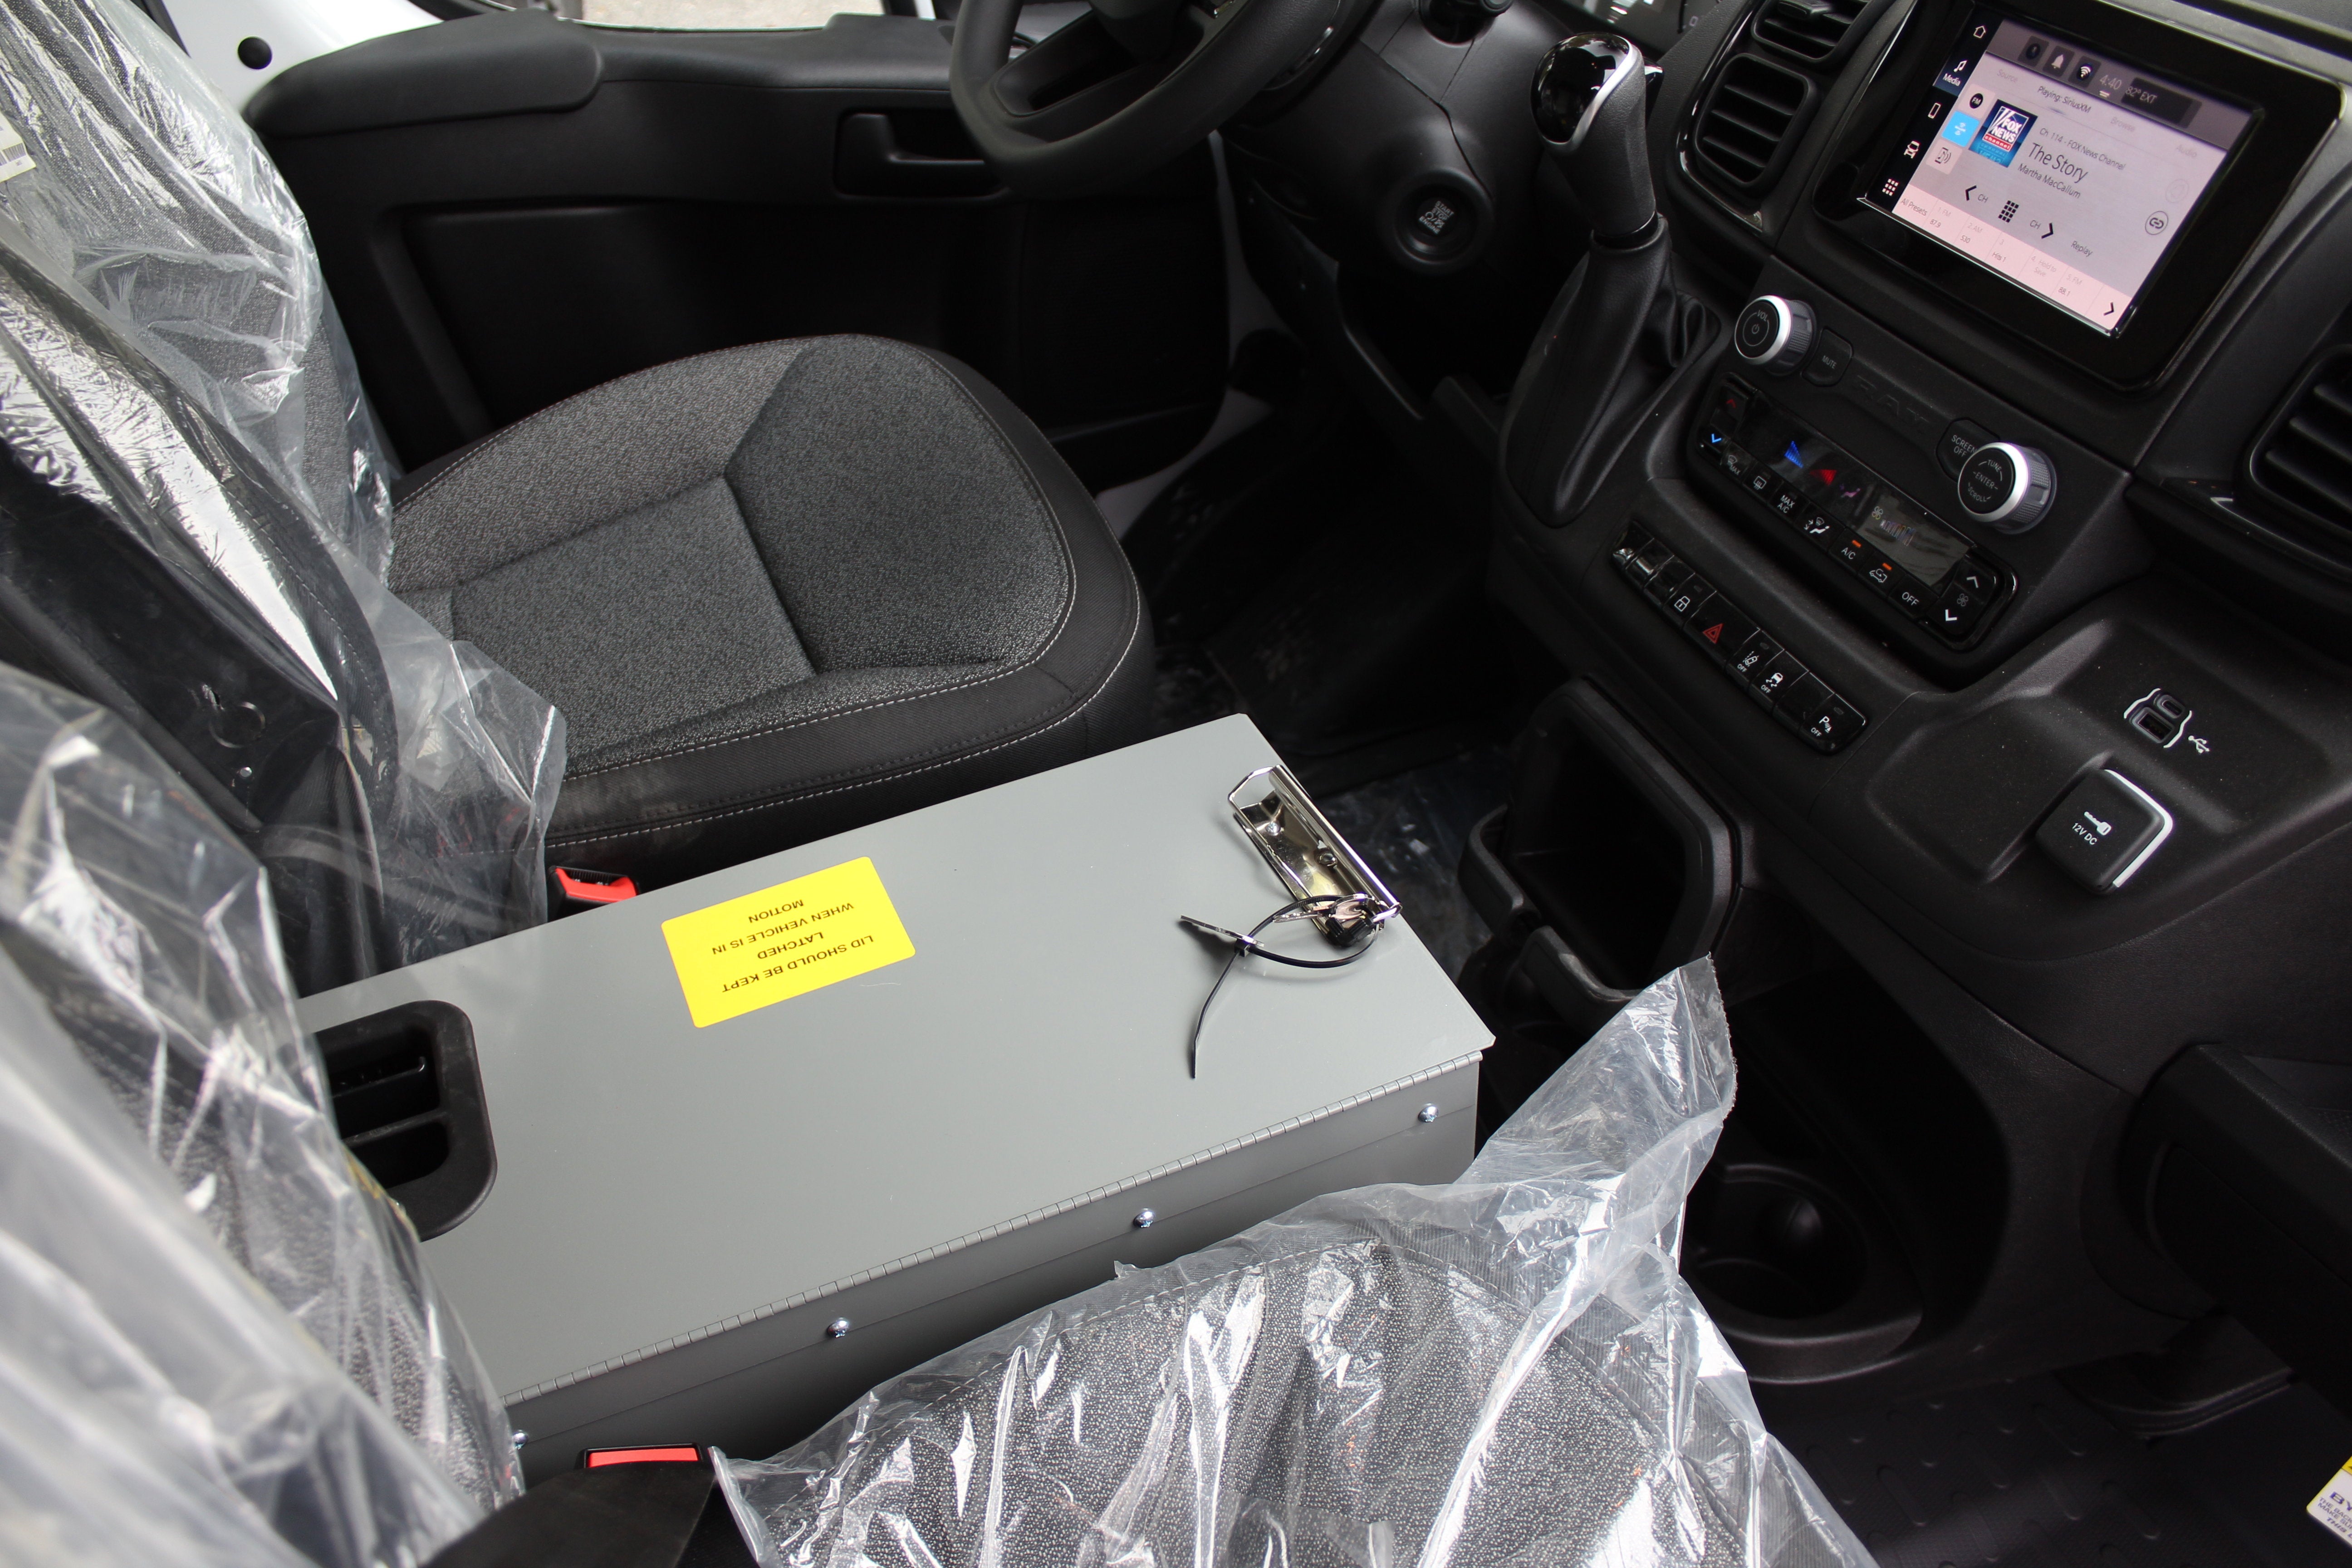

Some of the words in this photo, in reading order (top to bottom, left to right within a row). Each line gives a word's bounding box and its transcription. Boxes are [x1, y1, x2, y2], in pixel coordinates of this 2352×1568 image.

[1943, 74, 1960, 86] Media
[1997, 69, 2018, 83] Source
[2100, 75, 2122, 90] 4:40
[2140, 91, 2157, 103] EXT
[2038, 86, 2062, 103] Playing:
[2062, 96, 2092, 113] SiriusXM
[2001, 118, 2022, 134] FOX
[2110, 117, 2135, 131] Browse
[1991, 126, 2017, 143] NEWS
[1984, 136, 2010, 149] channel
[2051, 132, 2064, 142] 114
[2067, 140, 2081, 152] FOX
[2082, 146, 2098, 159] News
[2098, 154, 2127, 170] Channel
[2028, 142, 2052, 165] The
[2052, 155, 2088, 183] Story
[2018, 163, 2042, 181] Martha
[2042, 175, 2081, 199] MacCallum
[1977, 193, 1988, 203] CH
[1432, 207, 1447, 220] STOP
[1435, 201, 1454, 216] START
[1901, 198, 1909, 206] All
[1908, 201, 1927, 216] Presets
[1419, 216, 1441, 235] ENGINE
[1930, 219, 1941, 228] 87.9
[1972, 225, 1983, 234] AM
[2030, 220, 2041, 229] CH
[1960, 235, 1971, 244] 530
[2071, 240, 2093, 257] Replay
[1992, 251, 2003, 261] Hits
[2034, 267, 2047, 277] Save
[2038, 260, 2051, 270] Hold
[2072, 277, 2082, 285] FM
[2058, 287, 2071, 297] 88.1
[1757, 310, 1769, 322] VOL
[1821, 355, 1837, 370] MUTE
[1951, 435, 1978, 453] SCREEN
[1953, 446, 1967, 457] OFF
[1729, 464, 1741, 475] MAX
[1987, 460, 2002, 472] TUNE
[1975, 471, 1995, 490] ENTER
[1967, 486, 1987, 502] SCROLL
[1777, 502, 1789, 513] A/C
[1780, 495, 1795, 509] MAX
[1841, 547, 1856, 560] A/C
[1901, 592, 1919, 607] OFF
[1737, 664, 1747, 672] OFF
[1761, 684, 1771, 694] OFF
[1811, 727, 1822, 737] OFF
[2072, 823, 2087, 835] 12V
[2084, 833, 2097, 845] DC
[748, 899, 804, 923] MOTION
[811, 903, 854, 922] WHEN
[747, 918, 808, 944] VEHICLE
[730, 938, 744, 949] IS
[757, 931, 824, 959] LATCHED
[851, 935, 874, 949] LID
[712, 944, 727, 955] IN
[787, 944, 847, 970] SHOULD
[763, 966, 784, 979] BE
[722, 973, 760, 993] KEPT
[2319, 1497, 2334, 1509] THE
[2318, 1502, 2339, 1519] MAKE
[2327, 1517, 2347, 1533] THIS
